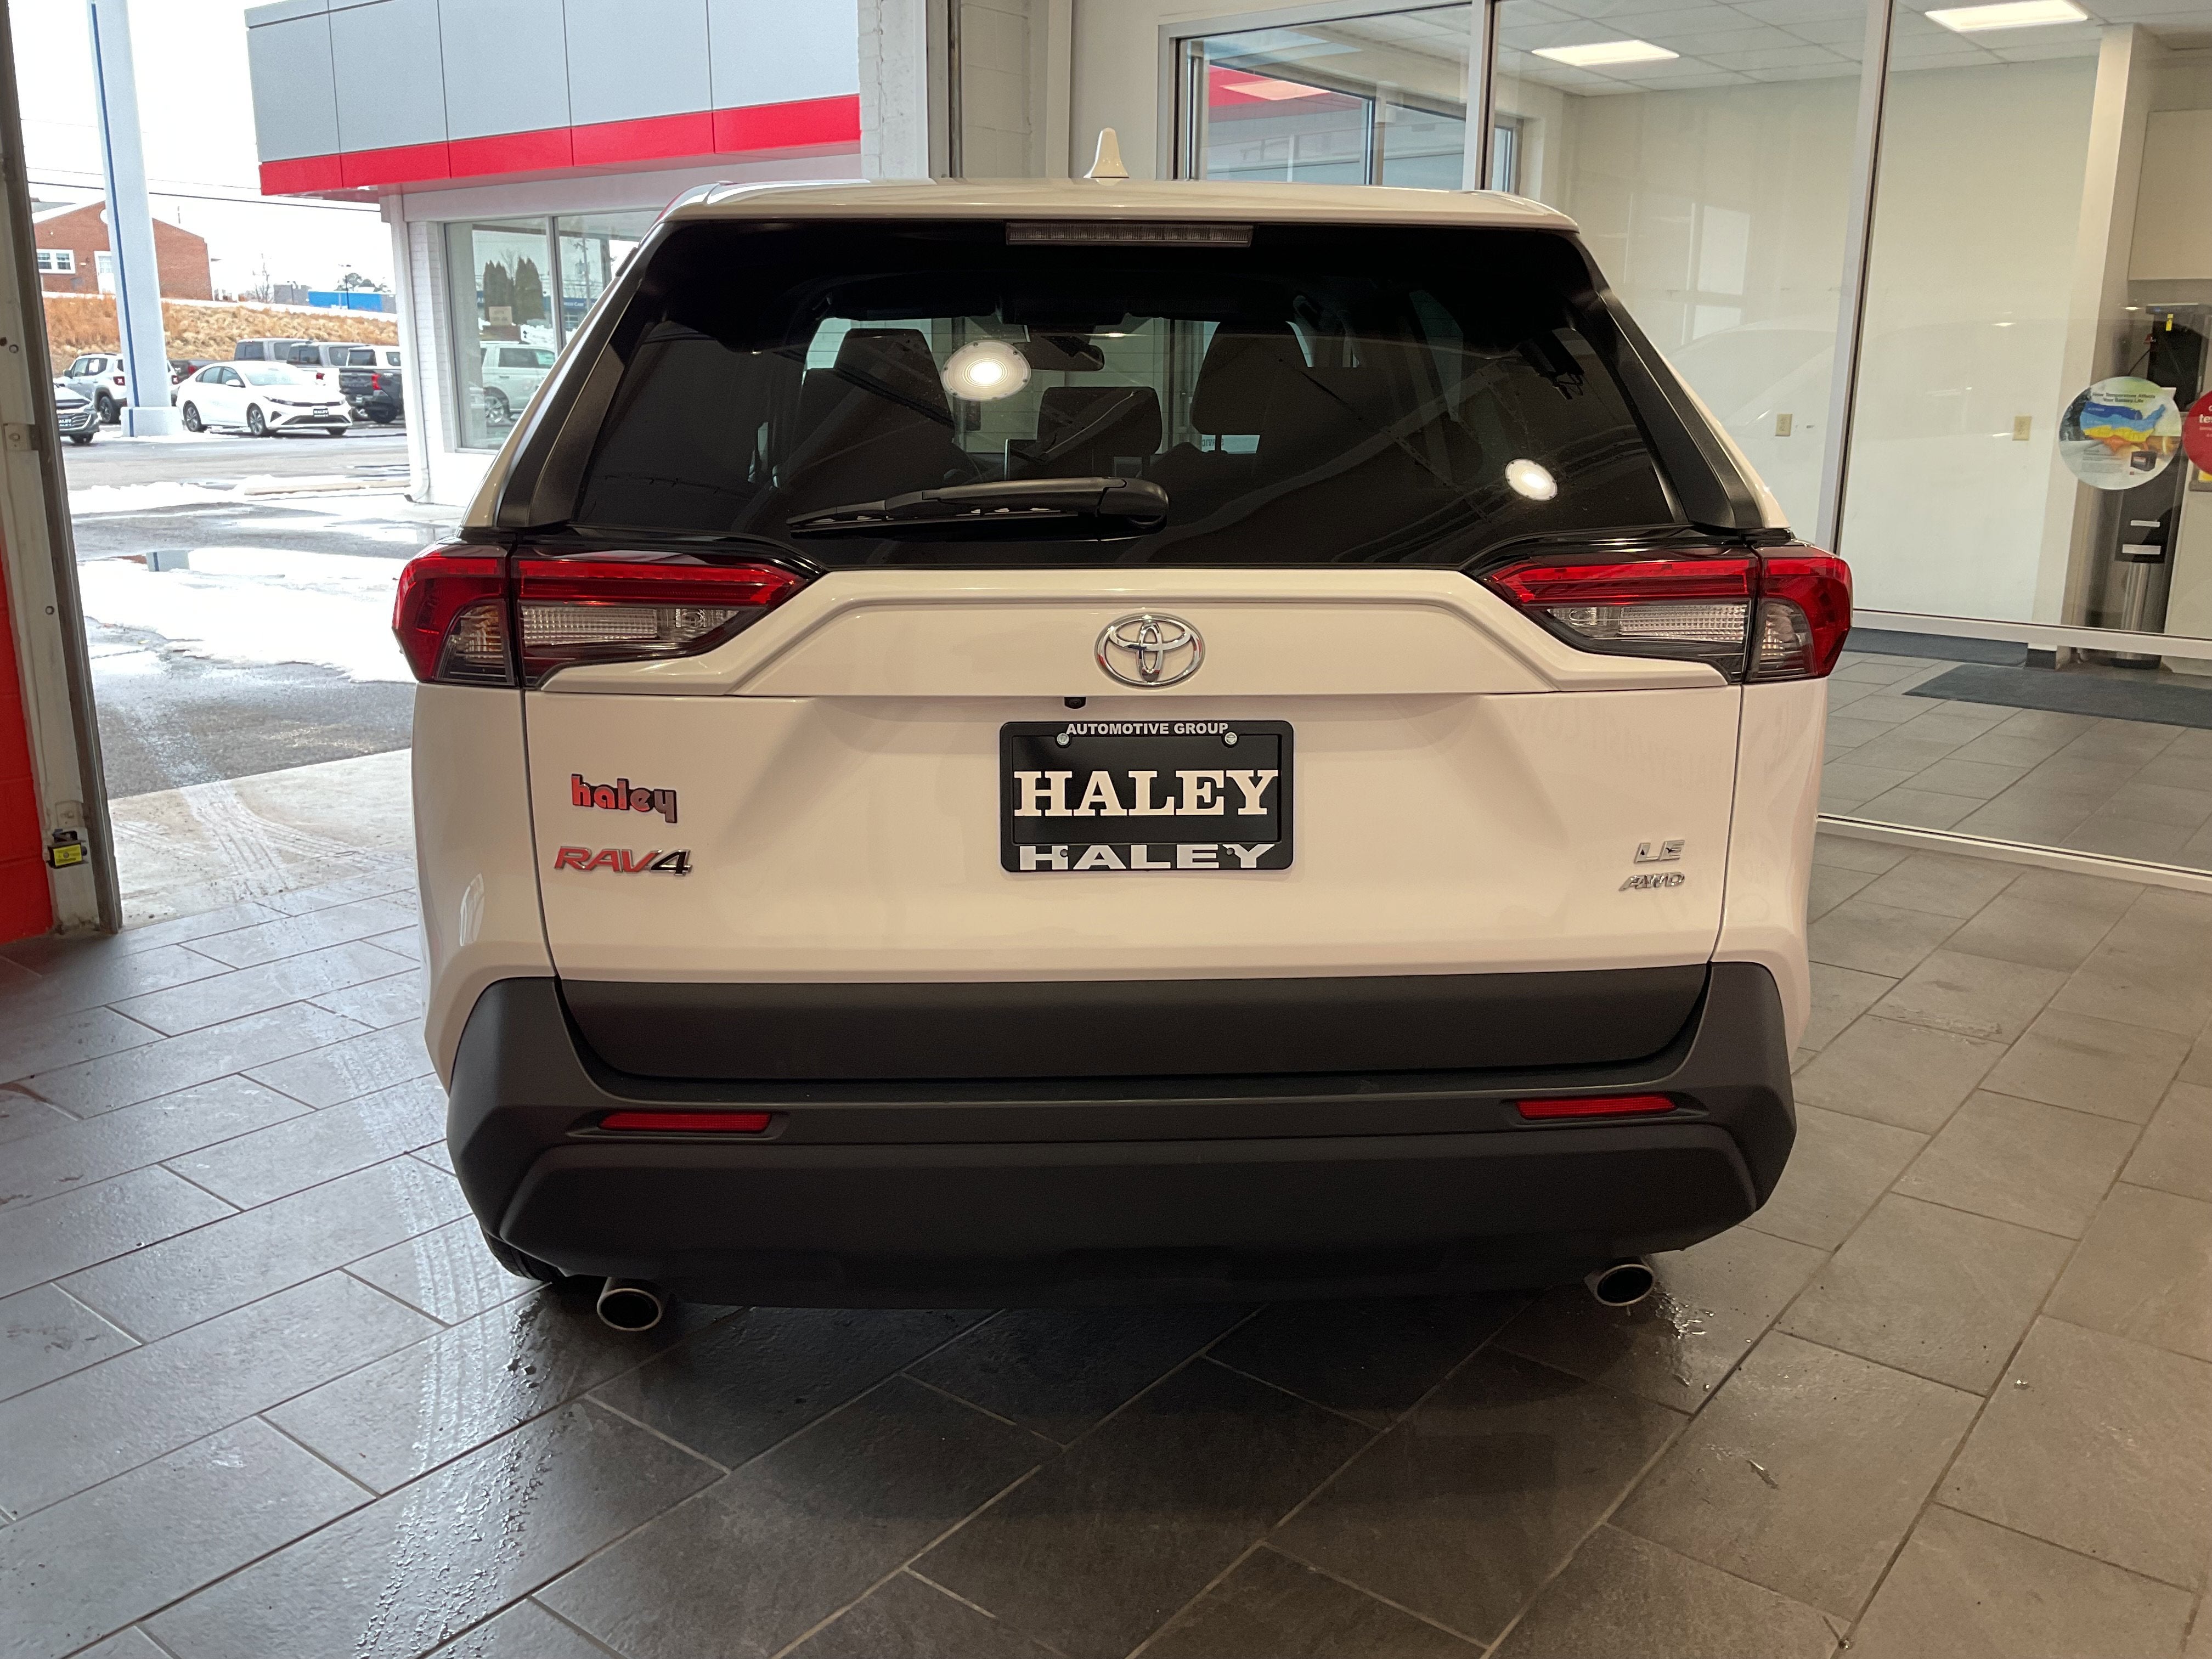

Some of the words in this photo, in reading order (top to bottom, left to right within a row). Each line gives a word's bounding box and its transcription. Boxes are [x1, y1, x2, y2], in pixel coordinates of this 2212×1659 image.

[1065, 723, 1169, 735] AUTOMOTIVE
[1173, 722, 1229, 735] GROUP
[571, 773, 678, 823] haley
[1013, 769, 1279, 817] HALEY
[554, 845, 693, 876] RAV4
[1019, 843, 1276, 871] HALEY
[1633, 839, 1685, 864] LE
[1618, 871, 1685, 892] AWD
